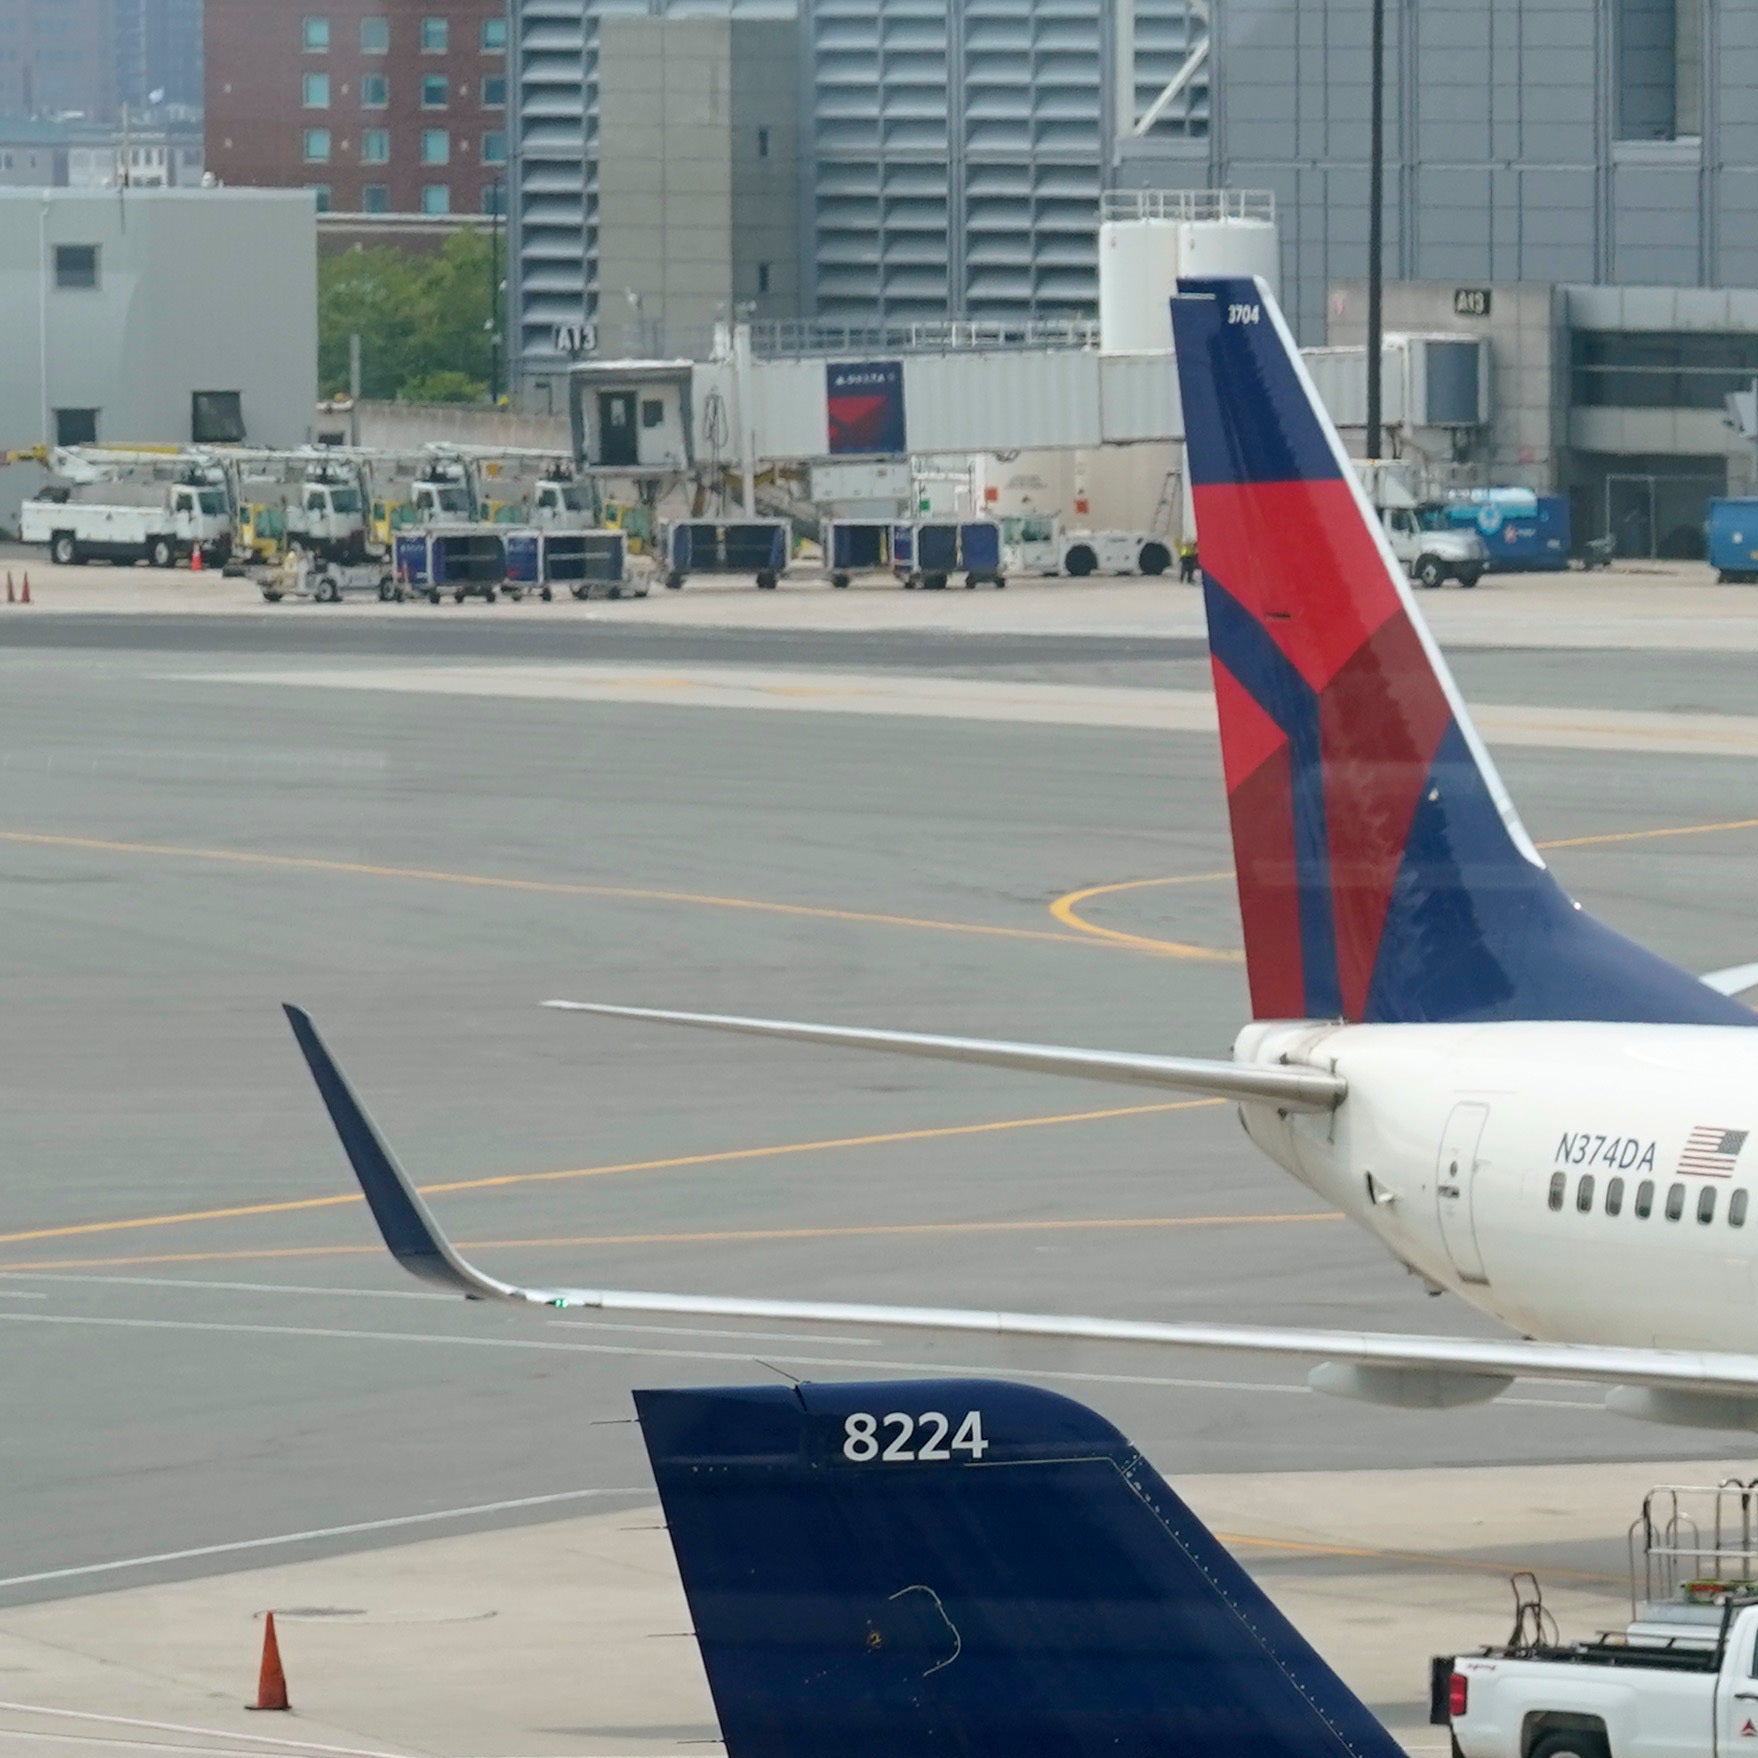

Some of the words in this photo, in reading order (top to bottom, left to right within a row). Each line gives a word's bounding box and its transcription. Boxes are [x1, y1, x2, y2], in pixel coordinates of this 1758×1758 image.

[1228, 303, 1260, 325] 3704
[1554, 1132, 1657, 1172] N374DA
[843, 1411, 989, 1462] 8224
